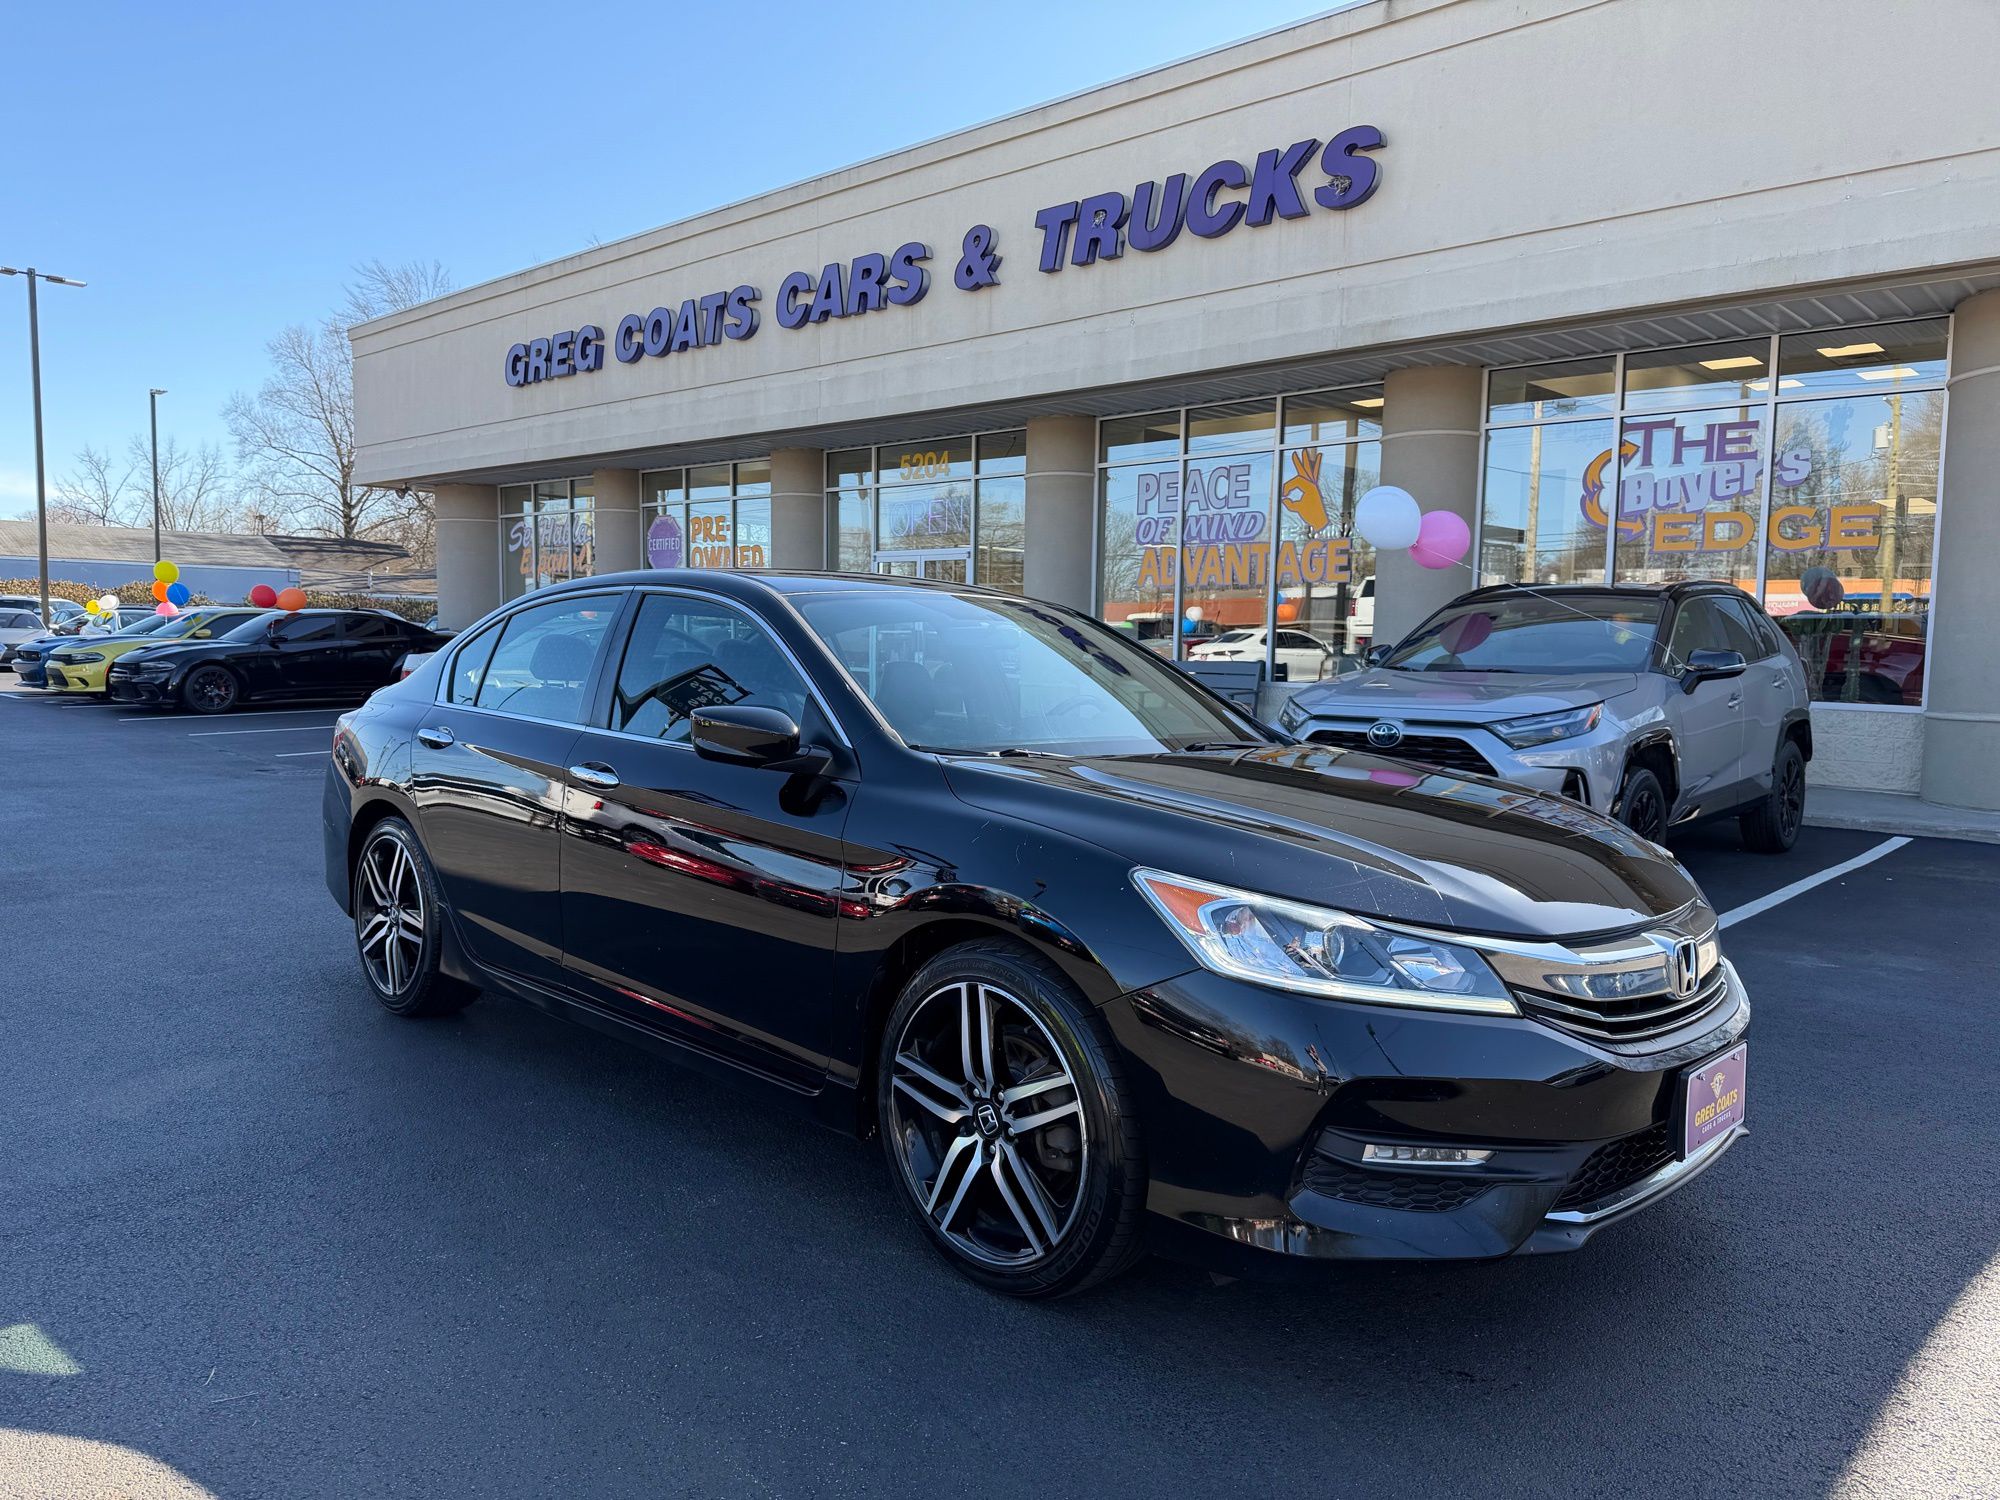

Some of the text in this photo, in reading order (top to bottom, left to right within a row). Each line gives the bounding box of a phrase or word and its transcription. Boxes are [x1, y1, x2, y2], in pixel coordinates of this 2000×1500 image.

[505, 125, 1387, 387] GREG COATS CARS & TRUCKS
[1621, 418, 1760, 467] THE
[900, 450, 950, 480] 5204
[1137, 464, 1251, 515] PEACE
[508, 513, 592, 552] Se Habla
[690, 515, 731, 543] PRE-
[889, 499, 964, 537] OPEN
[1136, 511, 1265, 545] OF MIND
[1649, 504, 1881, 555] EDGE
[648, 537, 681, 551] CERTIFIED
[691, 545, 765, 569] OWNED
[1136, 537, 1351, 589] ADVANTAGE
[1695, 1089, 1737, 1126] GREG COATS
